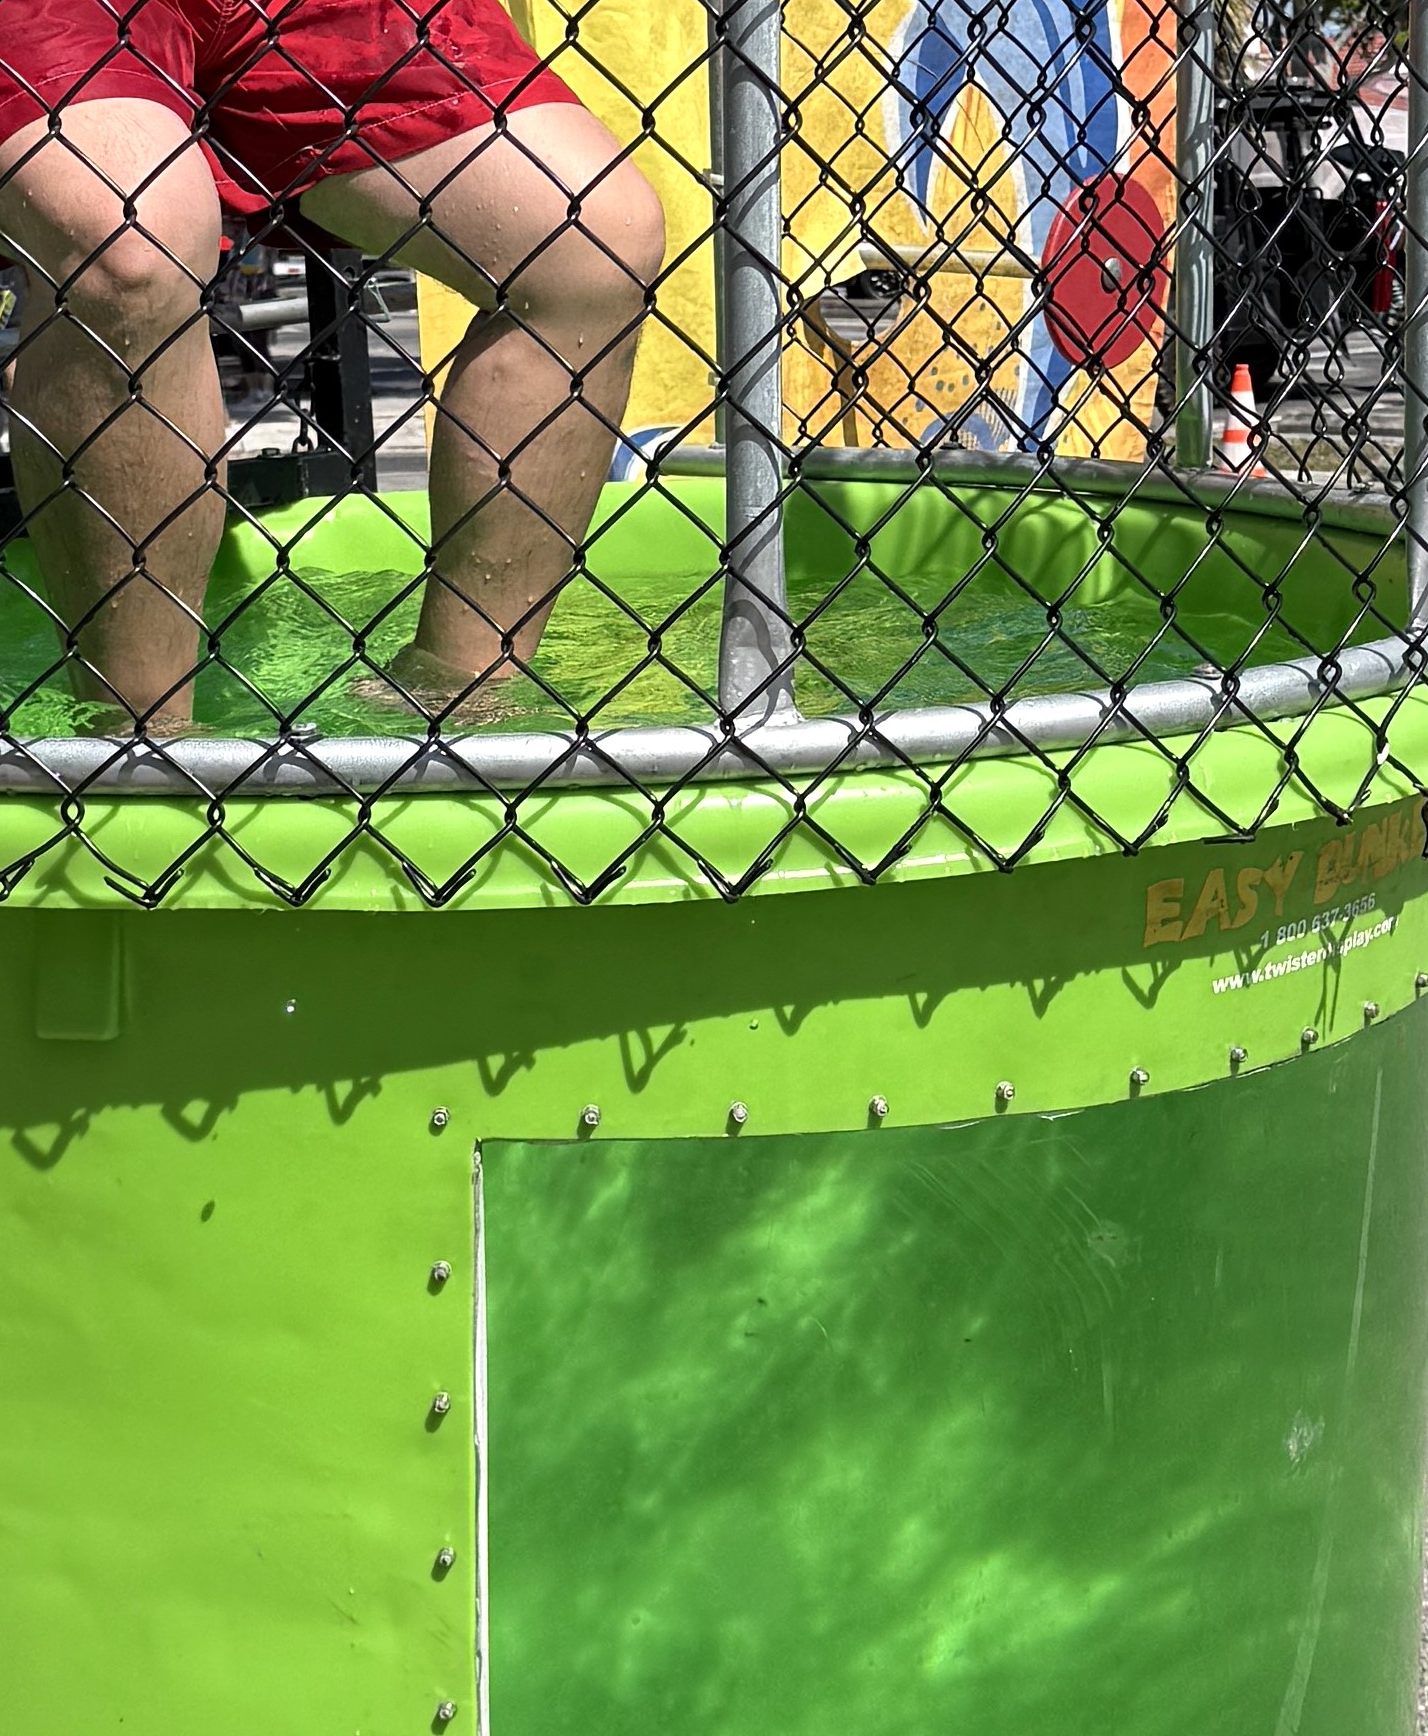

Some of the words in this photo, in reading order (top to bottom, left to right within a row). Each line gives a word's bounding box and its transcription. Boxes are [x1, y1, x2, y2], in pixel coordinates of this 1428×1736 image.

[1143, 850, 1305, 948] EASY
[1260, 930, 1270, 949] 1
[1275, 919, 1308, 946] 800
